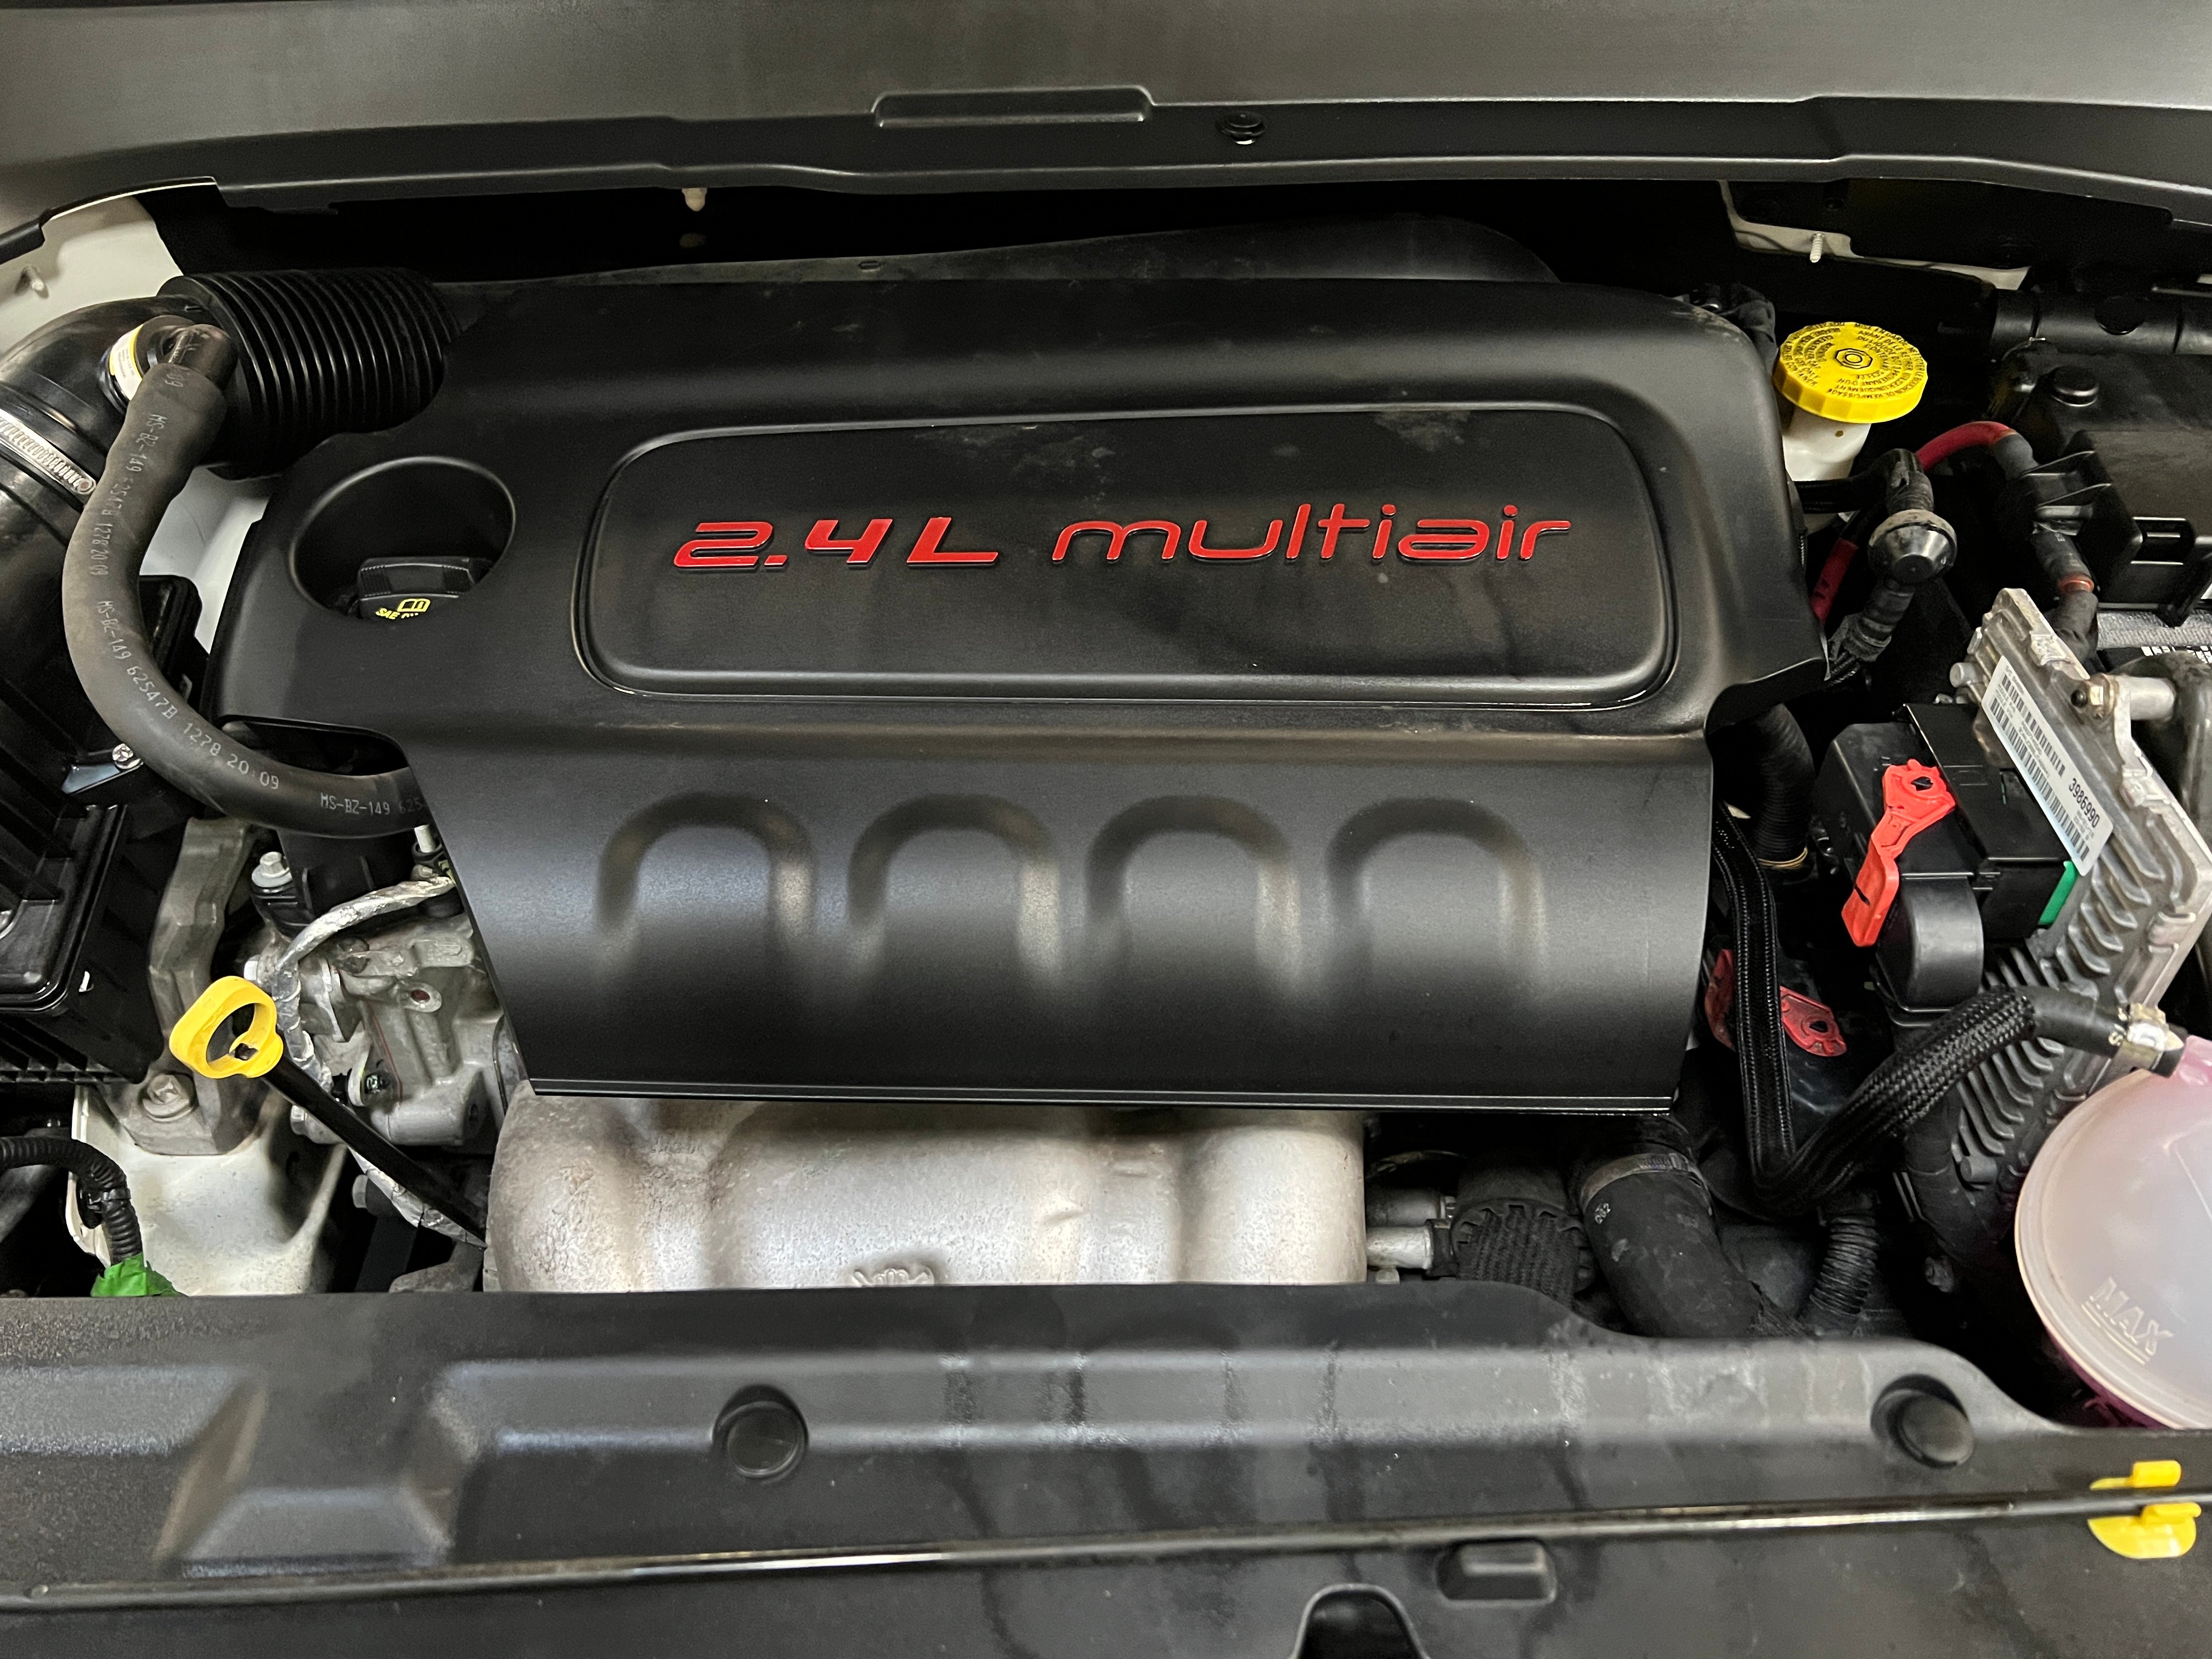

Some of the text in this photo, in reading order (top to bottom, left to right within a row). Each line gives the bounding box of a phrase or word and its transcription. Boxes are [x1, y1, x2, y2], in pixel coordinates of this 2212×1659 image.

[92, 523, 113, 544] 1278
[1052, 503, 1572, 561] multiair
[375, 608, 400, 619] SAE
[126, 666, 178, 719] 62547B
[183, 723, 222, 756] 1278
[2068, 777, 2100, 828] 3986990
[2089, 1277, 2175, 1357] MAX
